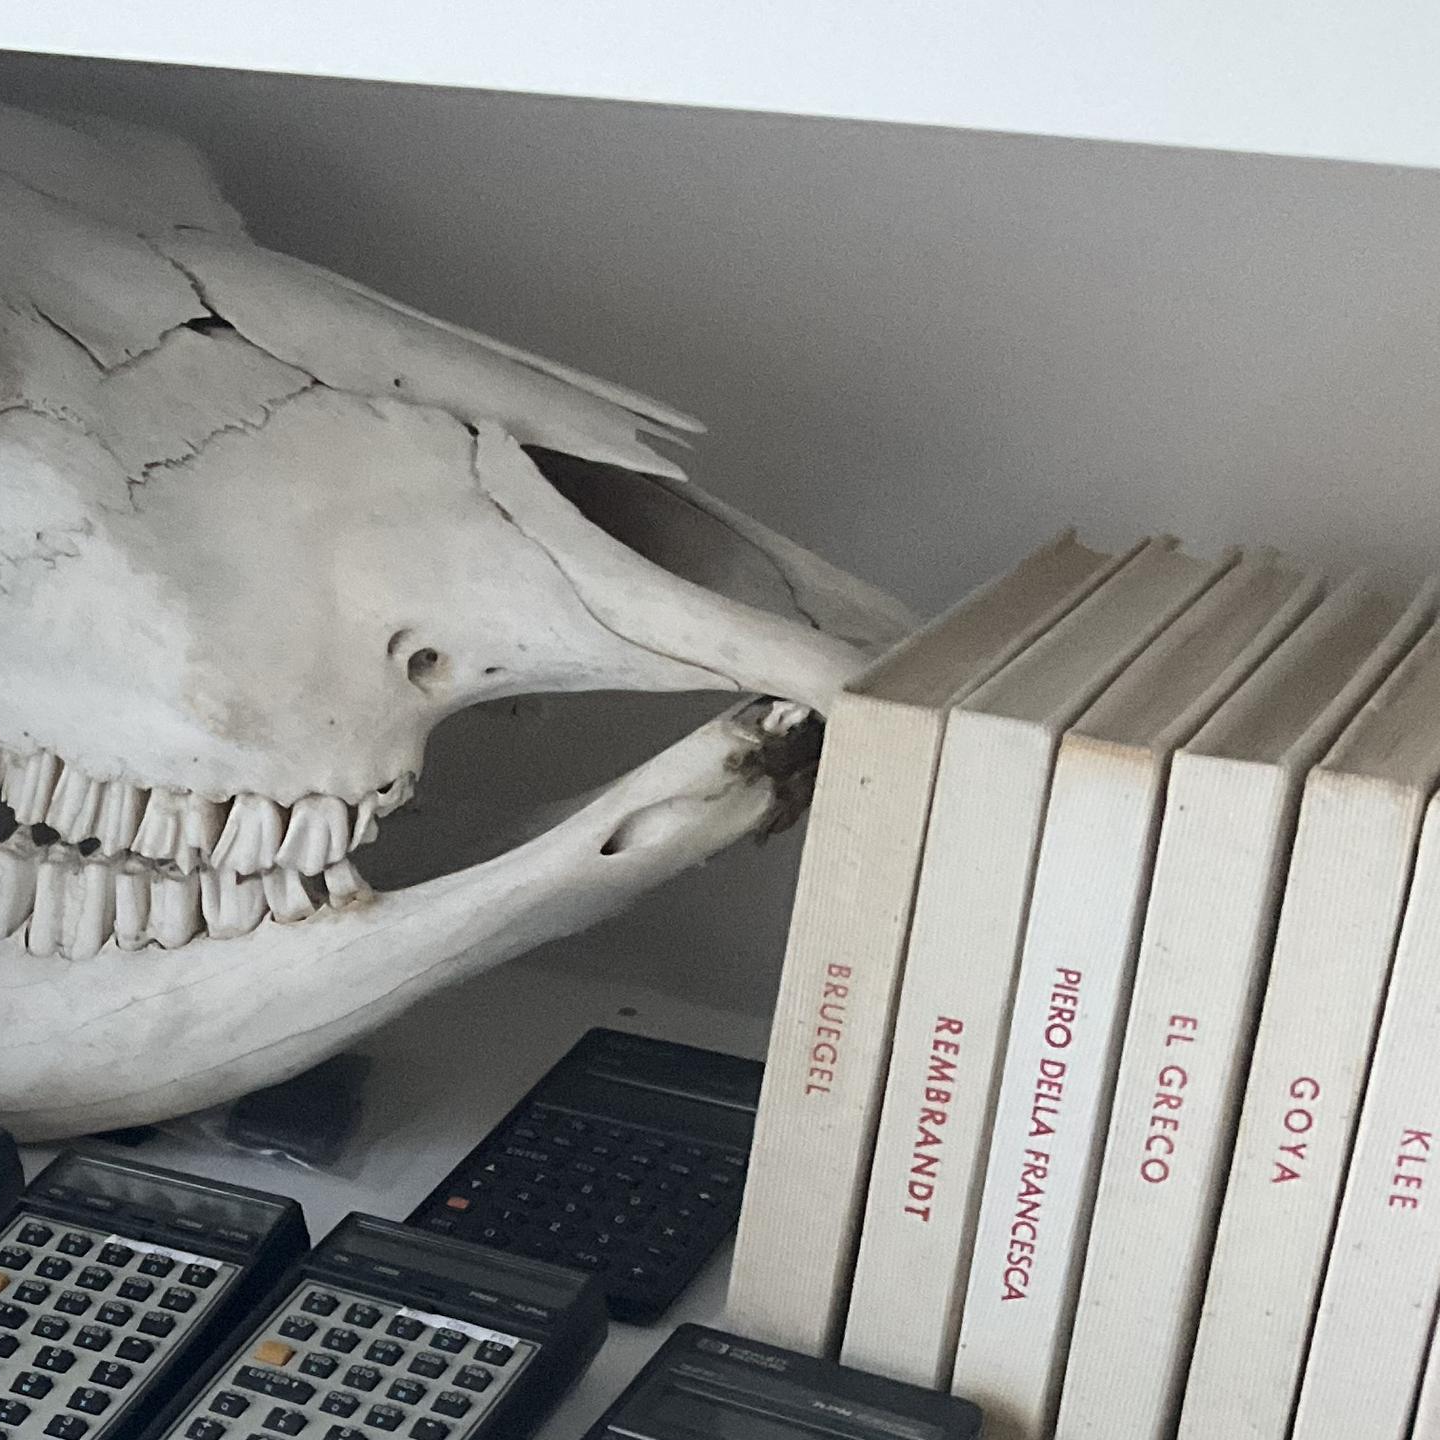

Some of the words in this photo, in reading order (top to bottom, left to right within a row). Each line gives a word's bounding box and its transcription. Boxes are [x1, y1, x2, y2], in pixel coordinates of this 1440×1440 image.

[806, 962, 852, 1095] BRUEGEL
[1044, 967, 1082, 1050] PIERO
[1166, 1014, 1198, 1047] EL
[904, 1015, 963, 1222] REMBRANDT
[1029, 1058, 1067, 1137] DELLA
[1141, 1065, 1188, 1184] GRECO
[1272, 1076, 1321, 1184] GOYA
[1387, 1128, 1433, 1210] KLEE
[1000, 1149, 1051, 1302] FRANCESCA
